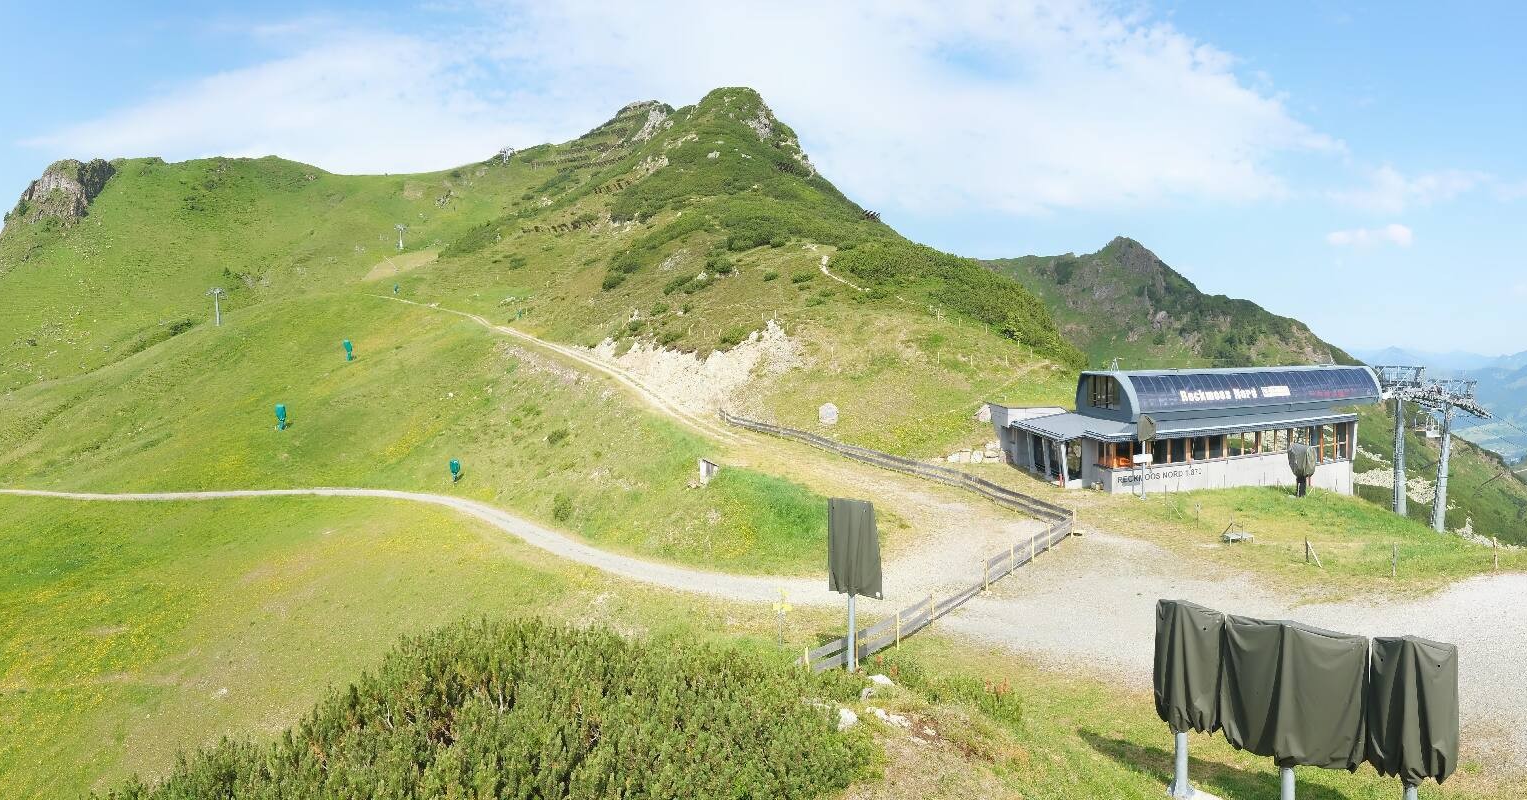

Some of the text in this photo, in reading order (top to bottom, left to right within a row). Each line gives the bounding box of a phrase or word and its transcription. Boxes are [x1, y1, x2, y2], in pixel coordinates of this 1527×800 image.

[1179, 389, 1231, 402] Reckmoos
[1233, 387, 1258, 400] Nord
[1162, 470, 1183, 479] NORD
